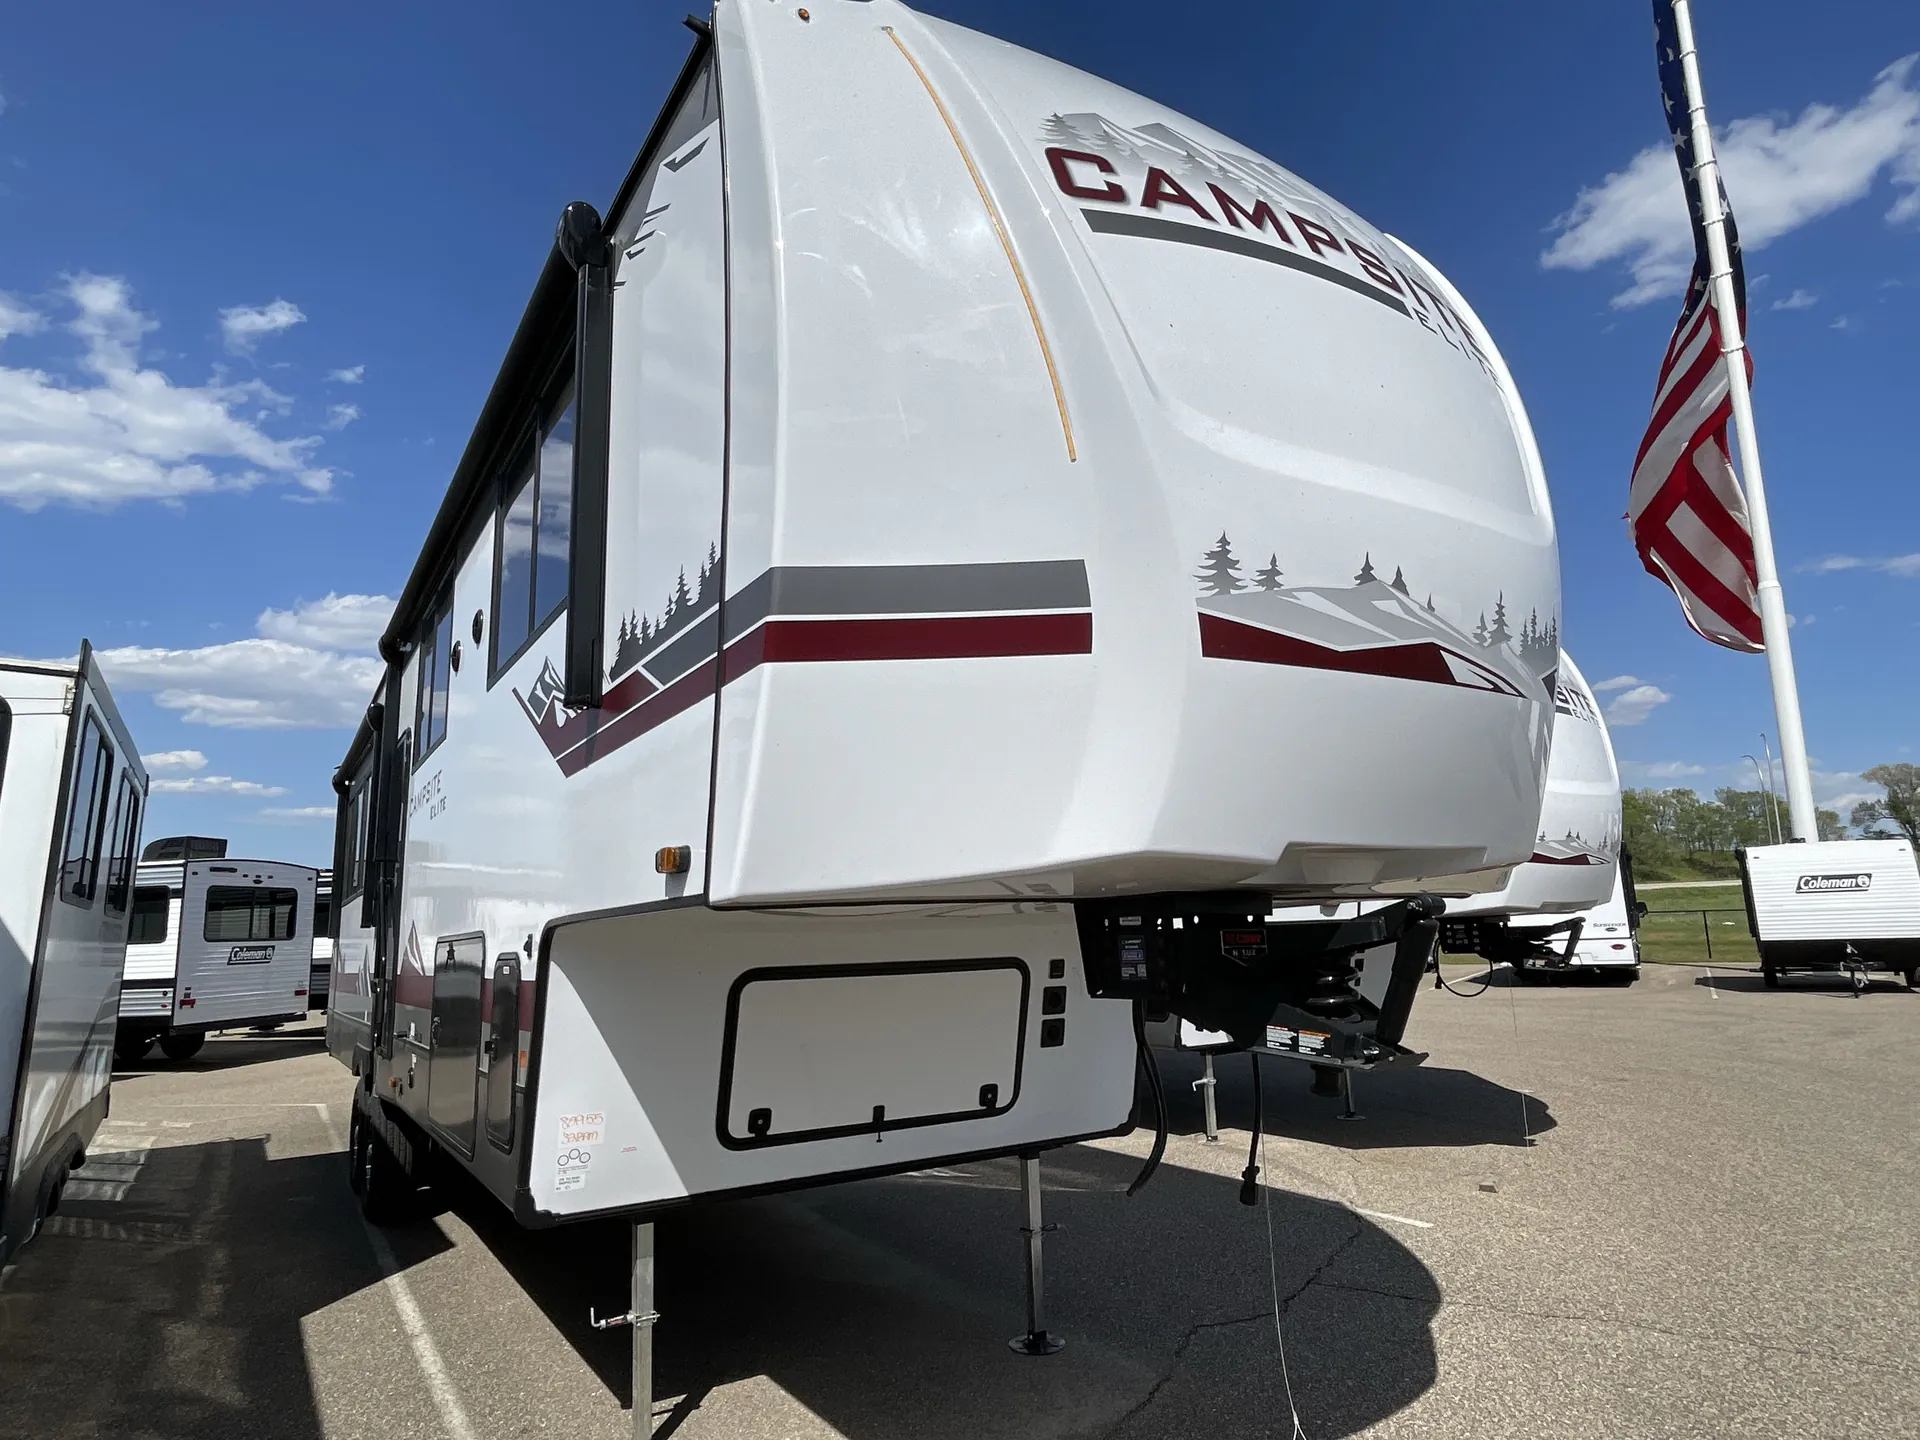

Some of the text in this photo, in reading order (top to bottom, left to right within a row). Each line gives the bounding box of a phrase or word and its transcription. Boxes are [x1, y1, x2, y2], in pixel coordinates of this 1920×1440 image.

[1045, 146, 1487, 360] CAMPSITE
[408, 769, 443, 818] CAMPSITE
[429, 795, 447, 820] ELITE
[1799, 876, 1857, 890] Coleman
[231, 947, 266, 961] Coleman
